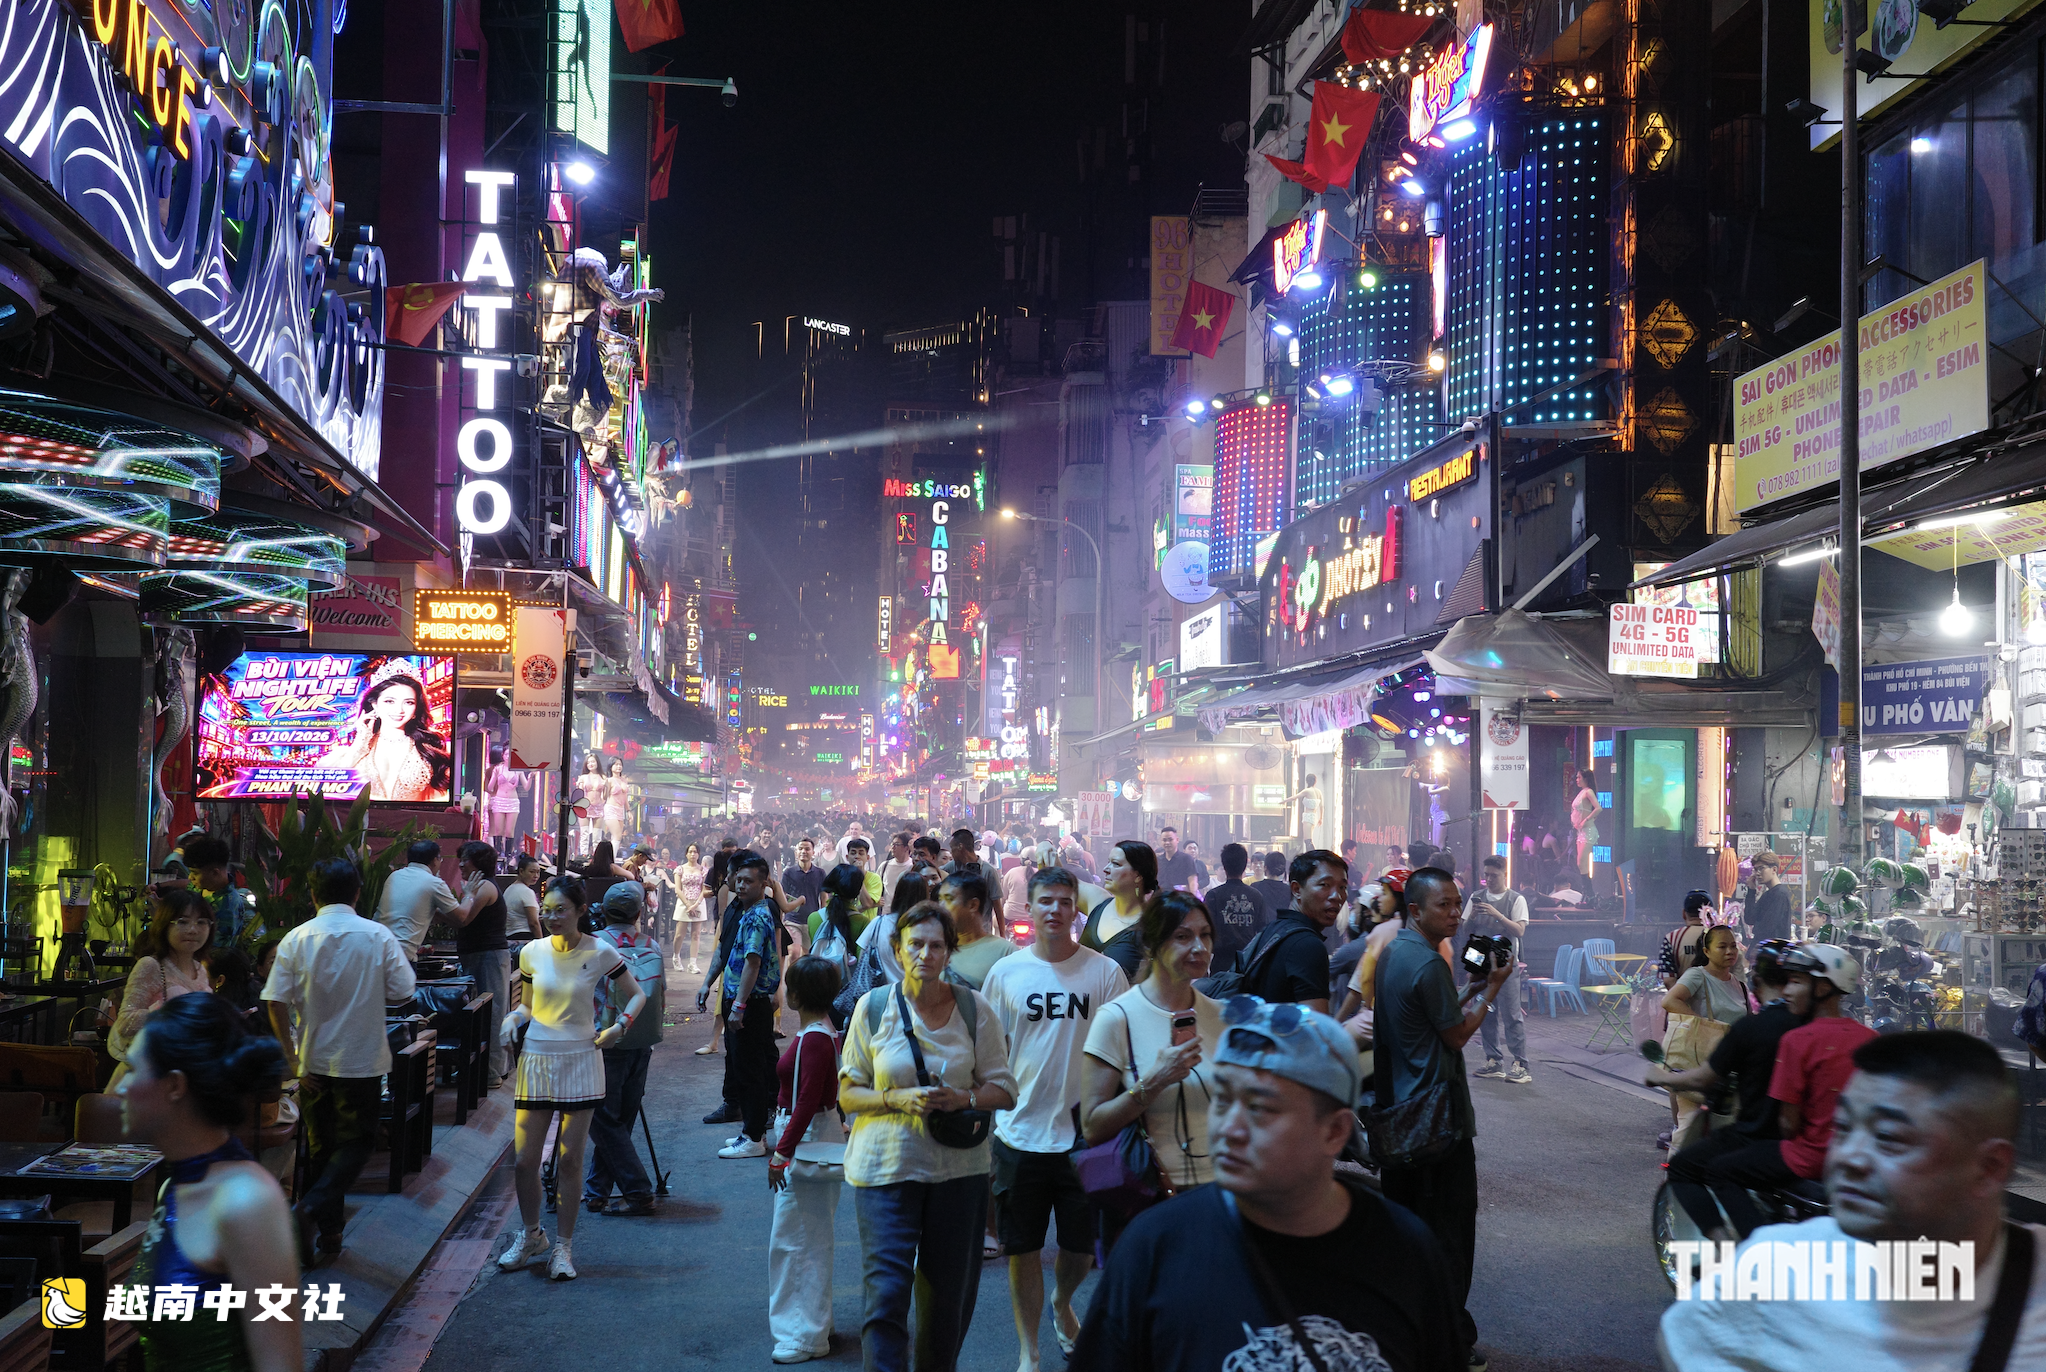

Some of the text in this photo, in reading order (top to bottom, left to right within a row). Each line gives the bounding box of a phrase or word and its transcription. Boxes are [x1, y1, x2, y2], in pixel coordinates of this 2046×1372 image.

[1426, 43, 1467, 110] Tiger
[1283, 220, 1308, 269] Tiger
[1154, 220, 1187, 352] 96 HOTEL
[804, 316, 851, 336] LANCASTER
[1741, 377, 1761, 406] SAI
[1766, 360, 1797, 395] GON
[1859, 274, 1974, 353] ACCESSORIES
[456, 170, 515, 534] TATTOO
[1739, 434, 1760, 458] SIM
[1764, 425, 1781, 448] 5G
[1795, 388, 1873, 436] UNLIMED
[1879, 369, 1918, 403] DATA
[1936, 341, 1980, 380] ESIM
[1768, 475, 1783, 494] 078
[1784, 469, 1800, 489] 982
[1801, 460, 1822, 483] 1111
[1896, 413, 1952, 449] whatsapp)
[1410, 450, 1474, 502] RESTAURANT
[884, 479, 921, 498] MISS
[1178, 528, 1210, 539] Mass
[1972, 529, 2034, 549] PHONE
[1914, 540, 1940, 551] SIM
[930, 501, 949, 645] CABANA
[313, 606, 393, 628] Welcome
[429, 602, 498, 620] TATTOO
[1613, 604, 1697, 626] SIM CARD
[419, 622, 507, 640] PIERCING
[1620, 623, 1645, 641] 4G
[1665, 626, 1689, 643] 5G
[1612, 641, 1695, 659] UNLIMITED DATA
[245, 655, 352, 681] BÙI VIỆN
[1863, 672, 1882, 681] THÀNH
[1883, 667, 1895, 680] PHỐ
[1905, 667, 1915, 678] CHÍ
[1916, 667, 1933, 677] MINH
[1938, 663, 1964, 675] PHƯỜNG
[1965, 661, 1978, 673] BẾN
[232, 677, 361, 699] NIGHTLIFE
[810, 685, 860, 696] WAIKIKI
[1886, 682, 1897, 692] KHU
[1898, 679, 1909, 691] PHỐ
[1911, 681, 1917, 690] 19
[1922, 677, 1935, 689] HẺM
[1936, 679, 1944, 688] 84
[1944, 677, 1955, 688] BÙI
[1956, 677, 1970, 689] VIỆN
[262, 694, 339, 718] TOUR
[759, 695, 788, 707] RICE
[1883, 695, 1924, 725] PHỐ
[1930, 696, 1974, 722] VĂN
[233, 718, 248, 726] One
[249, 718, 272, 727] street,
[279, 718, 301, 726] wealth
[302, 718, 310, 728] of
[310, 719, 345, 728] experience
[250, 730, 331, 743] 13/10/2026
[863, 716, 871, 766] HOEL
[247, 782, 293, 793] PHAN
[322, 782, 352, 793] MƠ
[1081, 792, 1111, 802] 30.000
[1027, 991, 1090, 1022] SEN
